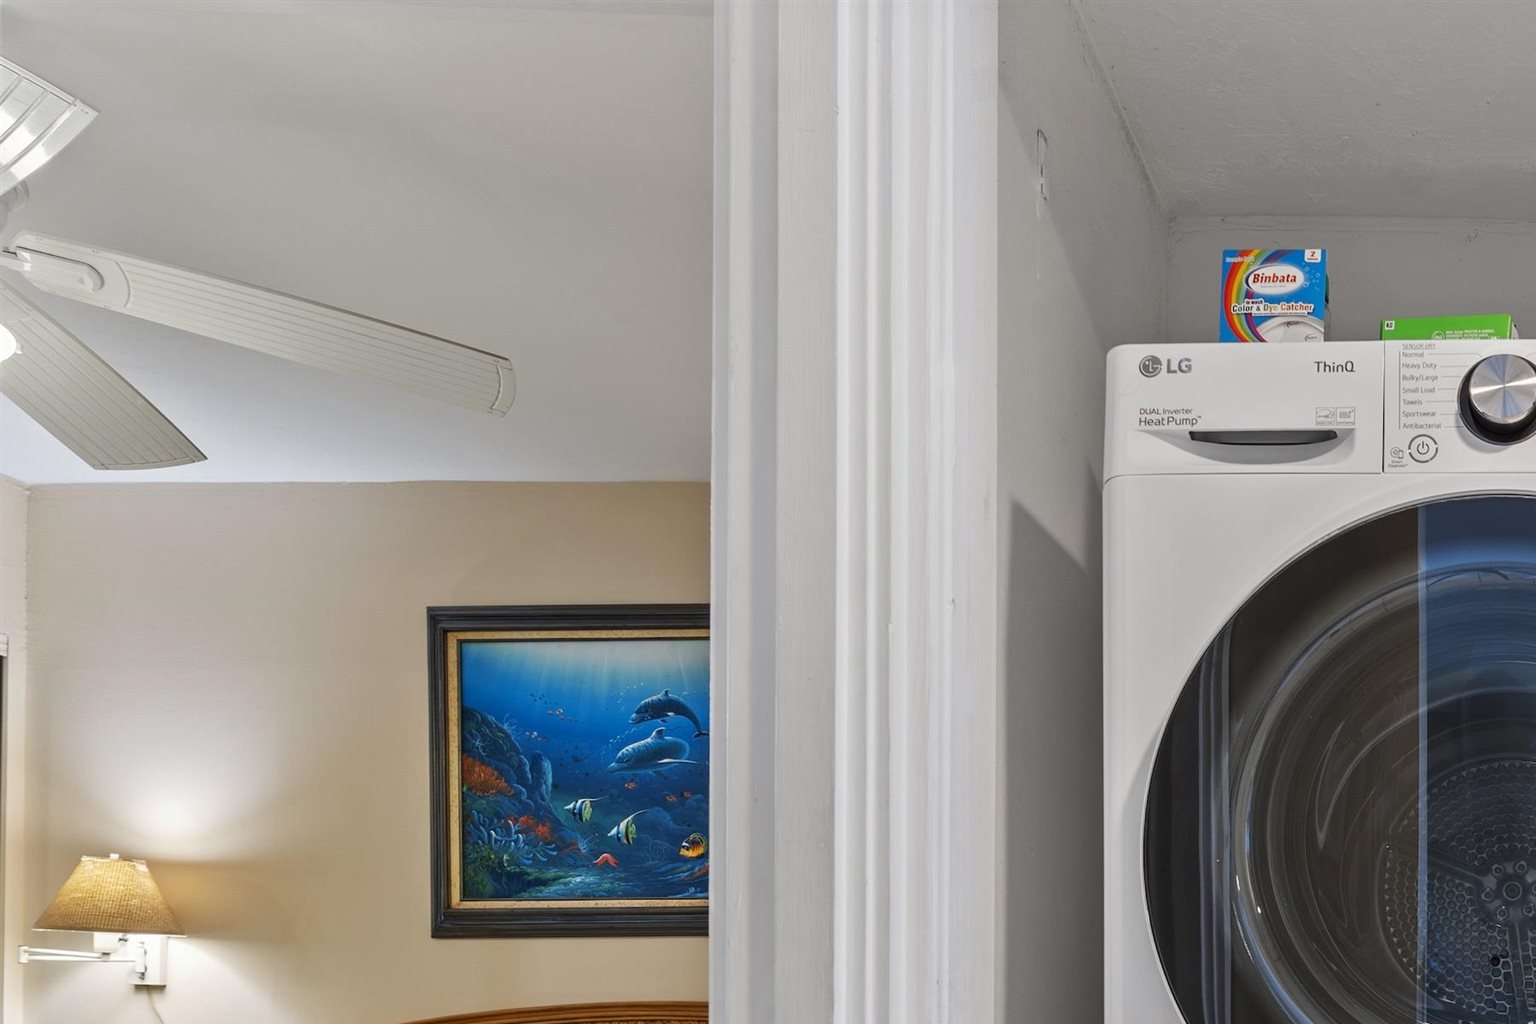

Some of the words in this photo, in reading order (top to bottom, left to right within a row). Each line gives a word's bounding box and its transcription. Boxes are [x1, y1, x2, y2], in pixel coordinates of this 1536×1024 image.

[1252, 272, 1297, 284] Binbata
[1232, 304, 1253, 312] Color
[1256, 304, 1261, 312] &
[1263, 304, 1278, 312] Dye
[1280, 302, 1313, 312] Catcher
[1166, 358, 1193, 374] LG
[1314, 360, 1356, 373] ThinQ
[1402, 362, 1420, 370] Heavy
[1422, 362, 1437, 370] Duty
[1402, 374, 1439, 382] Bulky/Large
[1162, 407, 1193, 415] Inverter
